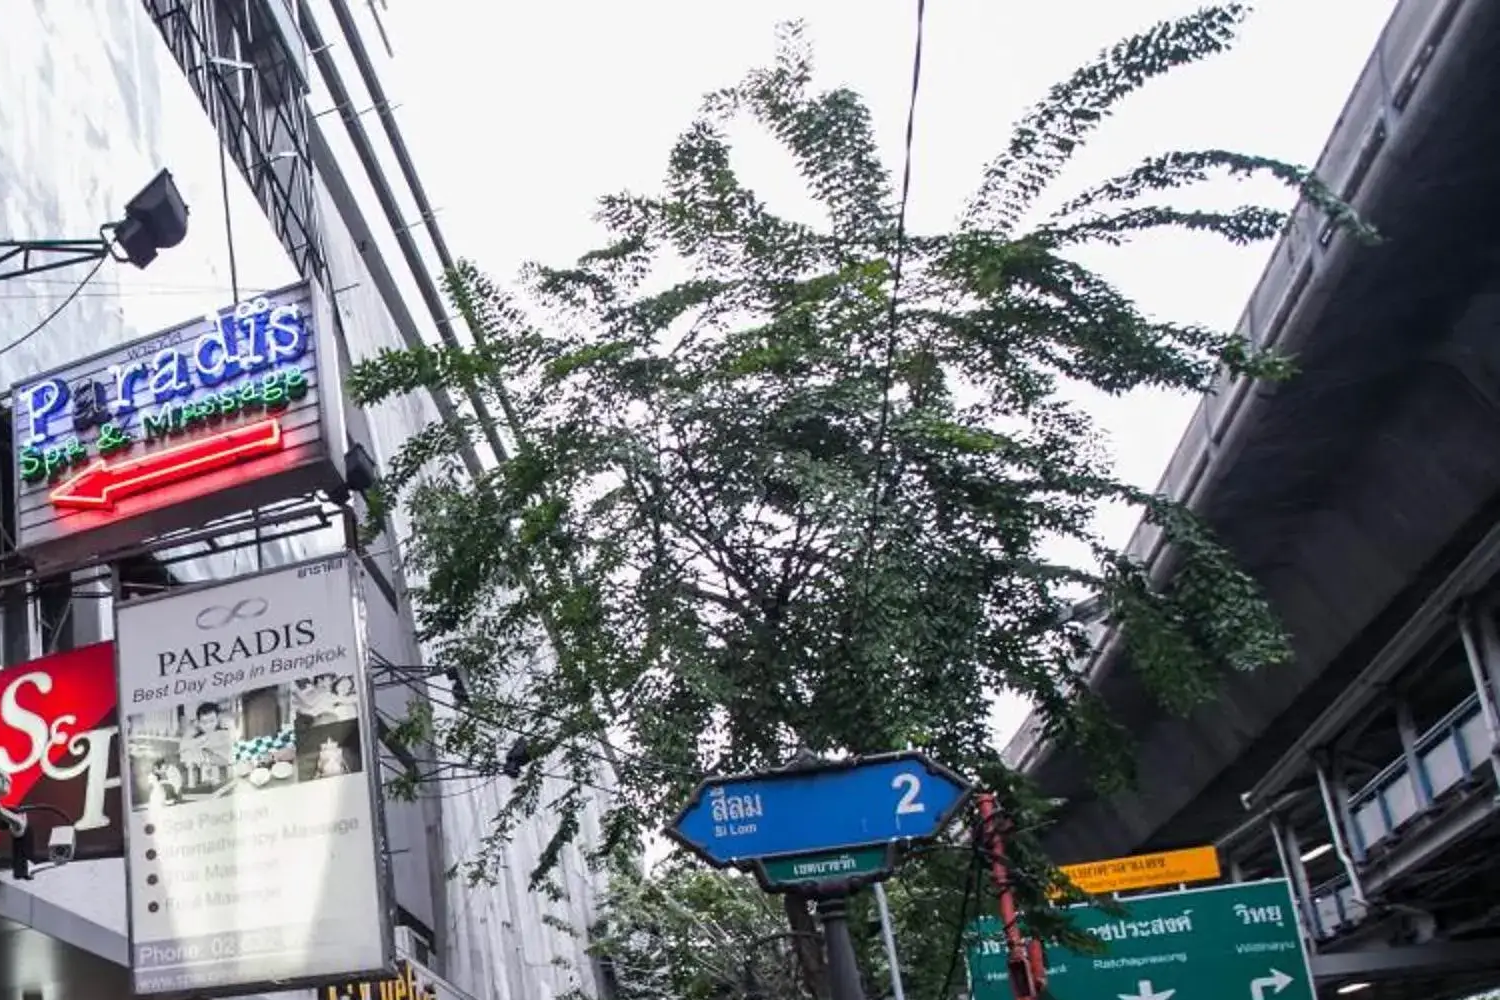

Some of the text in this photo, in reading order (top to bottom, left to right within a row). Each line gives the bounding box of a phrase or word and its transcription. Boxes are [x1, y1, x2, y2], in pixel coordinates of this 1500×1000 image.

[18, 366, 308, 481] Spa & Massage
[157, 619, 316, 677] PARADIS
[132, 645, 348, 703] Best Day Spa in Bangkok
[711, 786, 764, 823] สีลม
[890, 772, 926, 815] 2
[731, 822, 758, 836] Lom
[1087, 908, 1194, 942] าชประสงค์
[1233, 902, 1284, 928] วิทยุ
